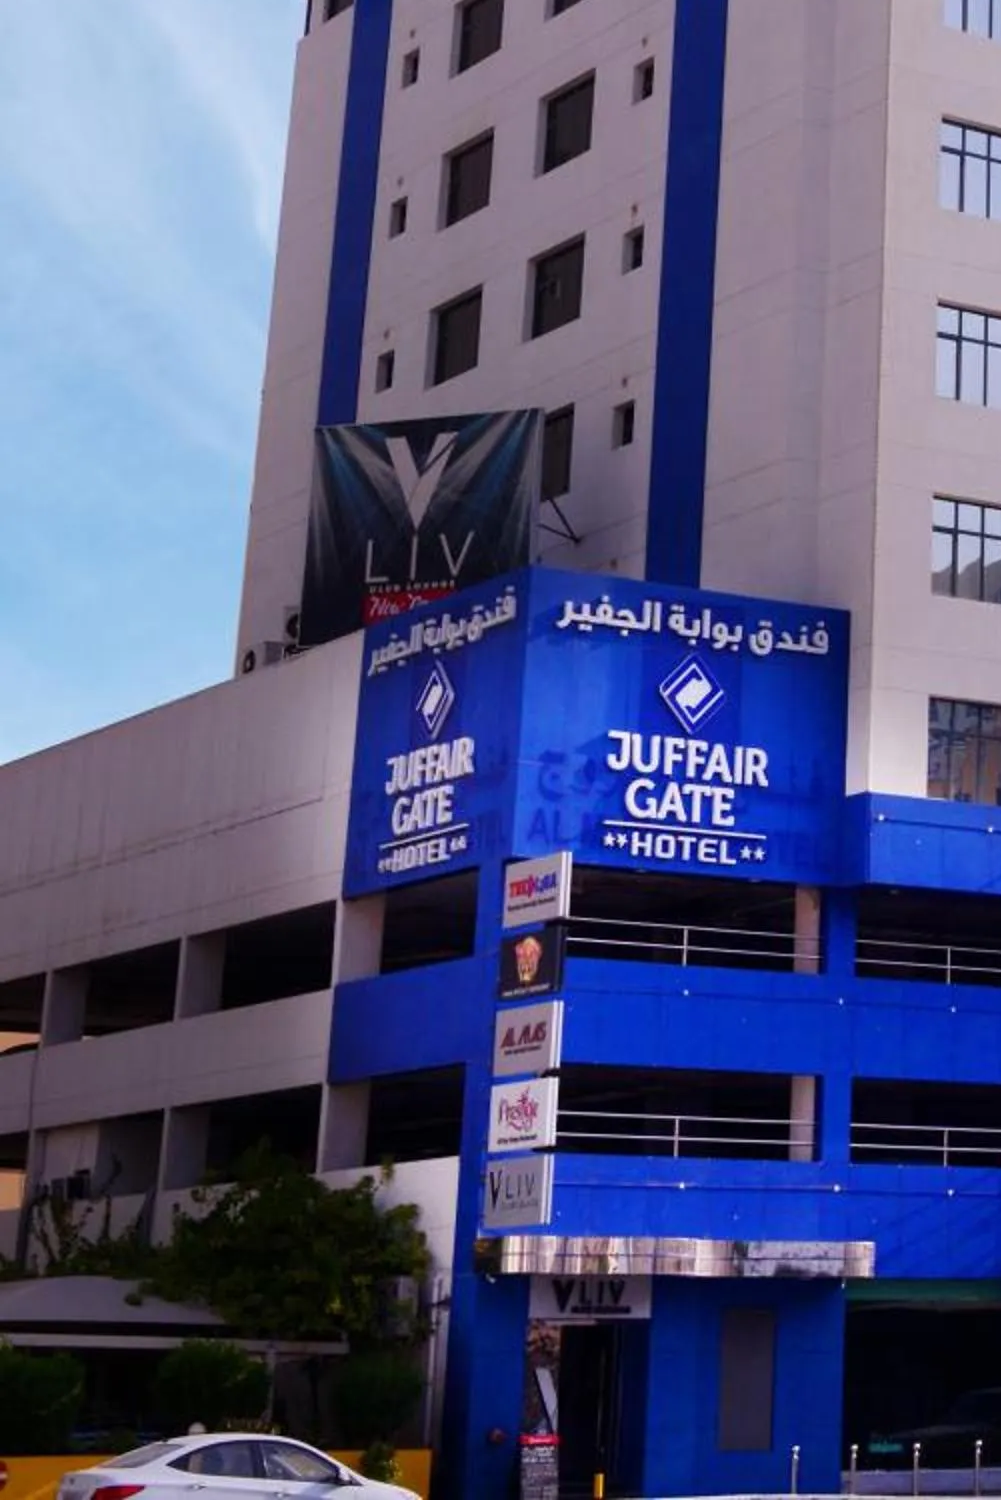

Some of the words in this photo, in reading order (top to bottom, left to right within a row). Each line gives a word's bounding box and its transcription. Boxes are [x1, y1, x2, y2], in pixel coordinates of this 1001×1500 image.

[365, 530, 475, 583] LIV
[423, 613, 467, 655] بوابة
[467, 585, 517, 642] فندق
[555, 595, 662, 637] الجفير
[667, 604, 743, 651] بوابة
[749, 620, 830, 655] فندق
[367, 622, 425, 677] الجفير
[385, 736, 475, 796] JUFFAIR
[606, 729, 769, 788] JUFFAIR
[392, 784, 455, 836] GATE
[624, 777, 735, 827] GATE
[391, 837, 452, 873] HOTEL
[630, 831, 737, 865] HOTEL
[505, 1172, 536, 1199] LIV
